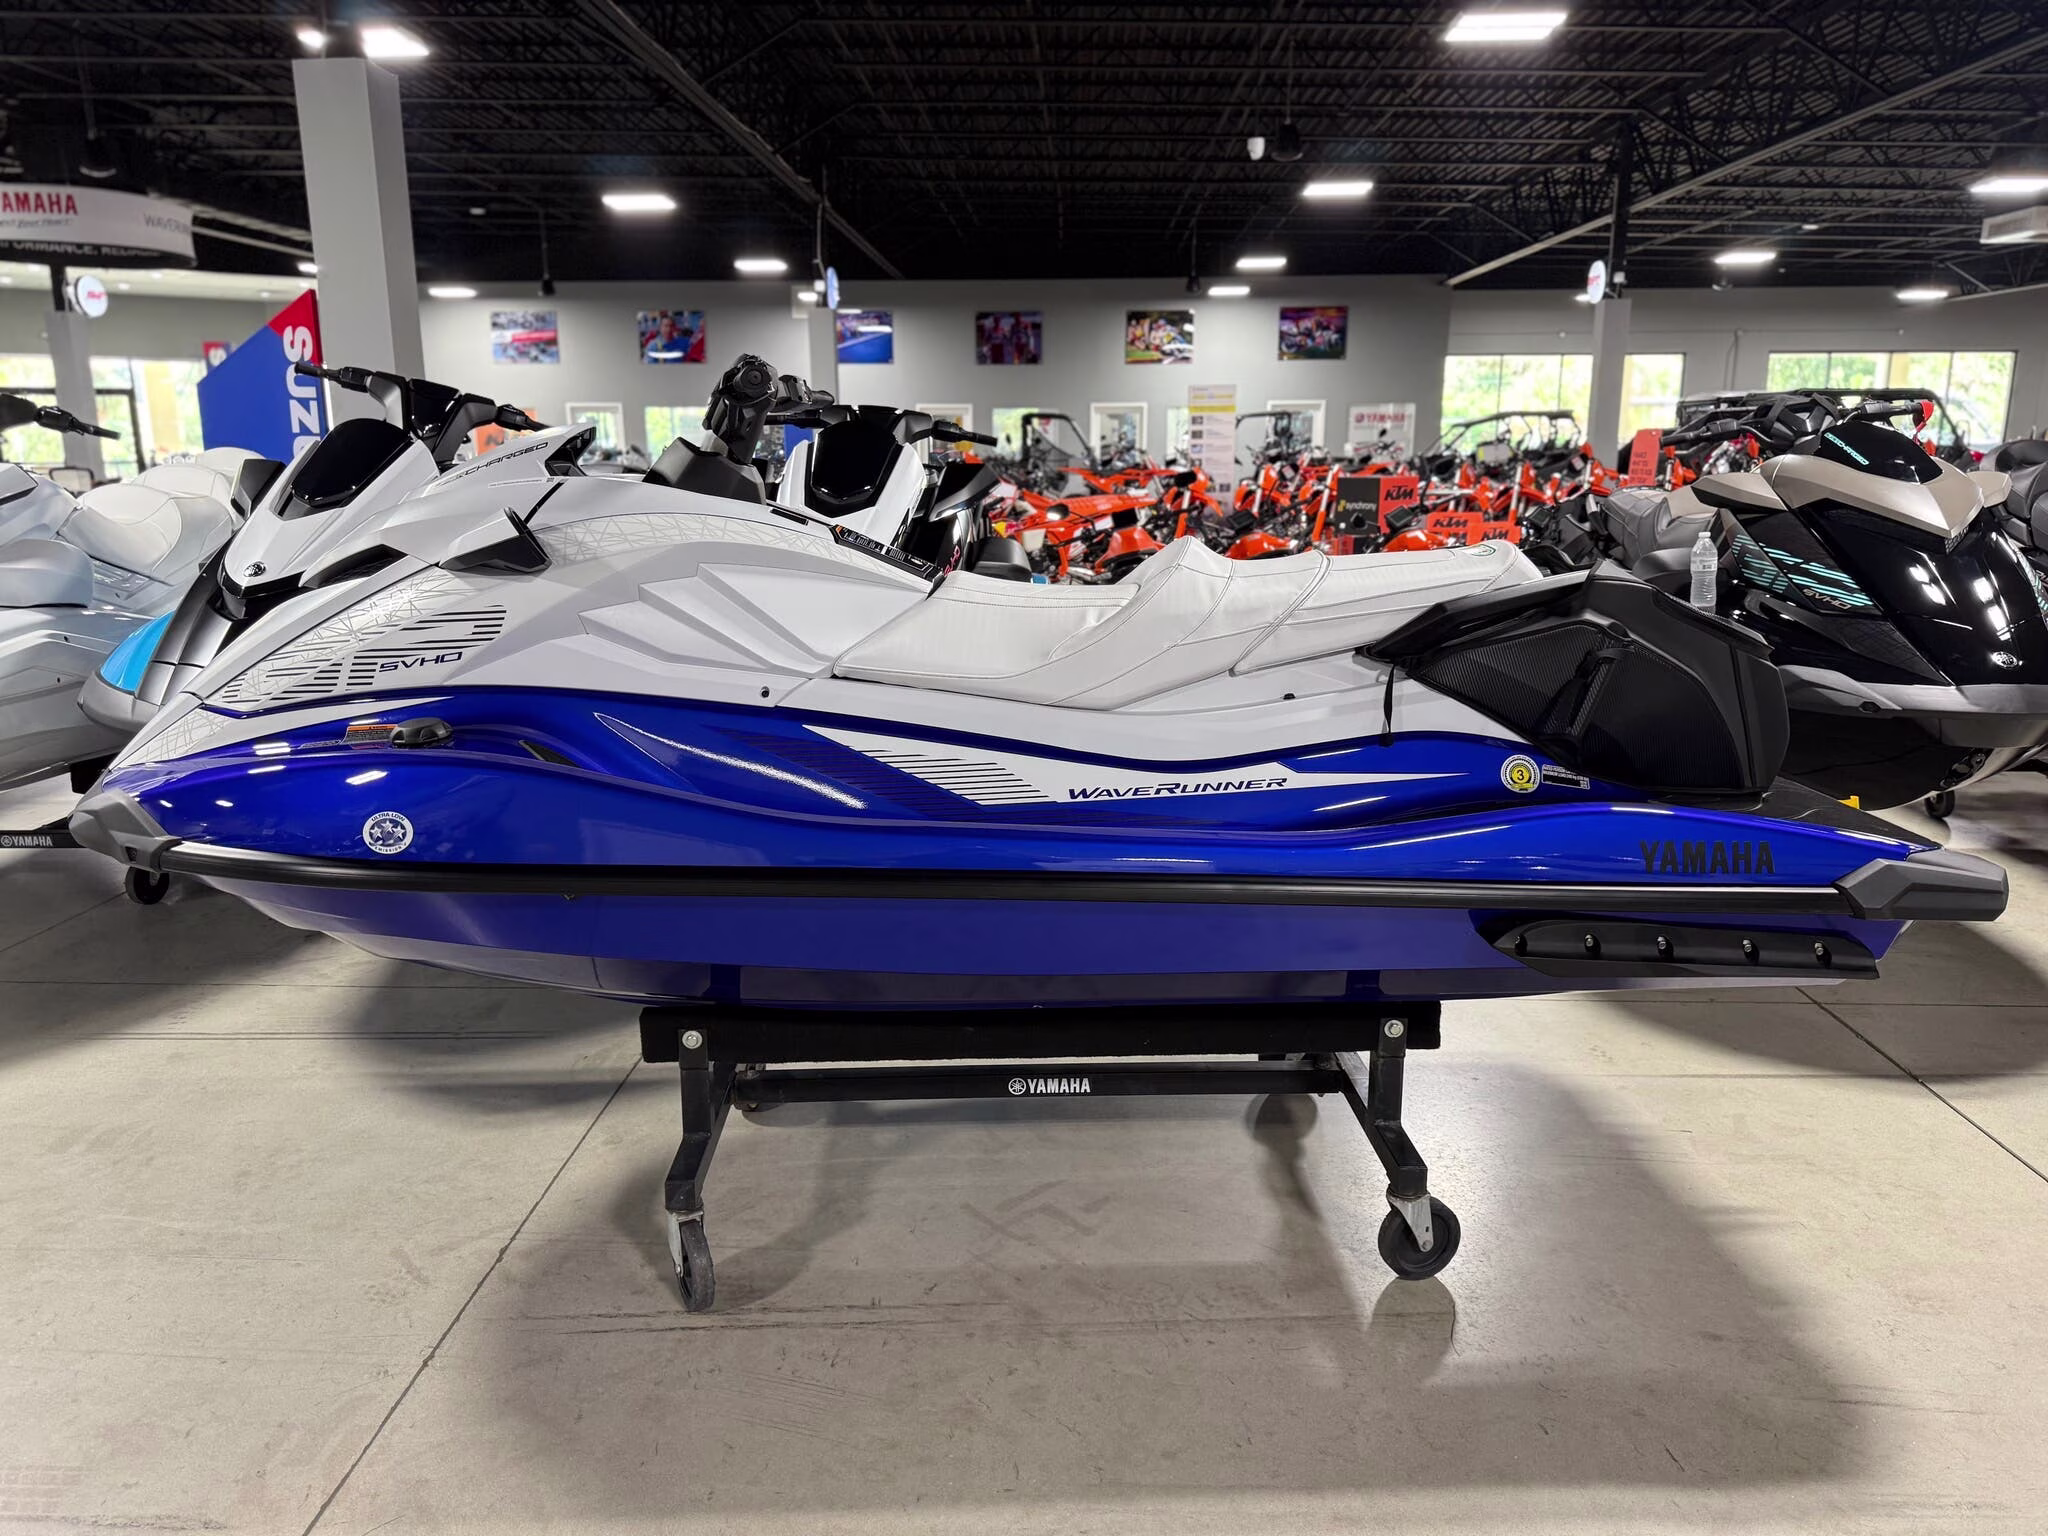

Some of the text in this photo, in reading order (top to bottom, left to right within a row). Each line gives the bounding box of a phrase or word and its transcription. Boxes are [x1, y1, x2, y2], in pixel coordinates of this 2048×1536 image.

[2, 191, 78, 215] AMAHA
[1385, 485, 1414, 501] KTM
[1345, 501, 1377, 512] synchrony
[1432, 516, 1468, 528] KTM
[1481, 527, 1509, 541] KTM
[379, 651, 463, 673] SVHO
[1516, 769, 1525, 781] 3
[371, 812, 406, 822] ULTRA LOW
[12, 835, 53, 847] YAMAHA
[1639, 839, 1776, 875] YAMAHA
[1027, 1077, 1091, 1094] YAMAHA
